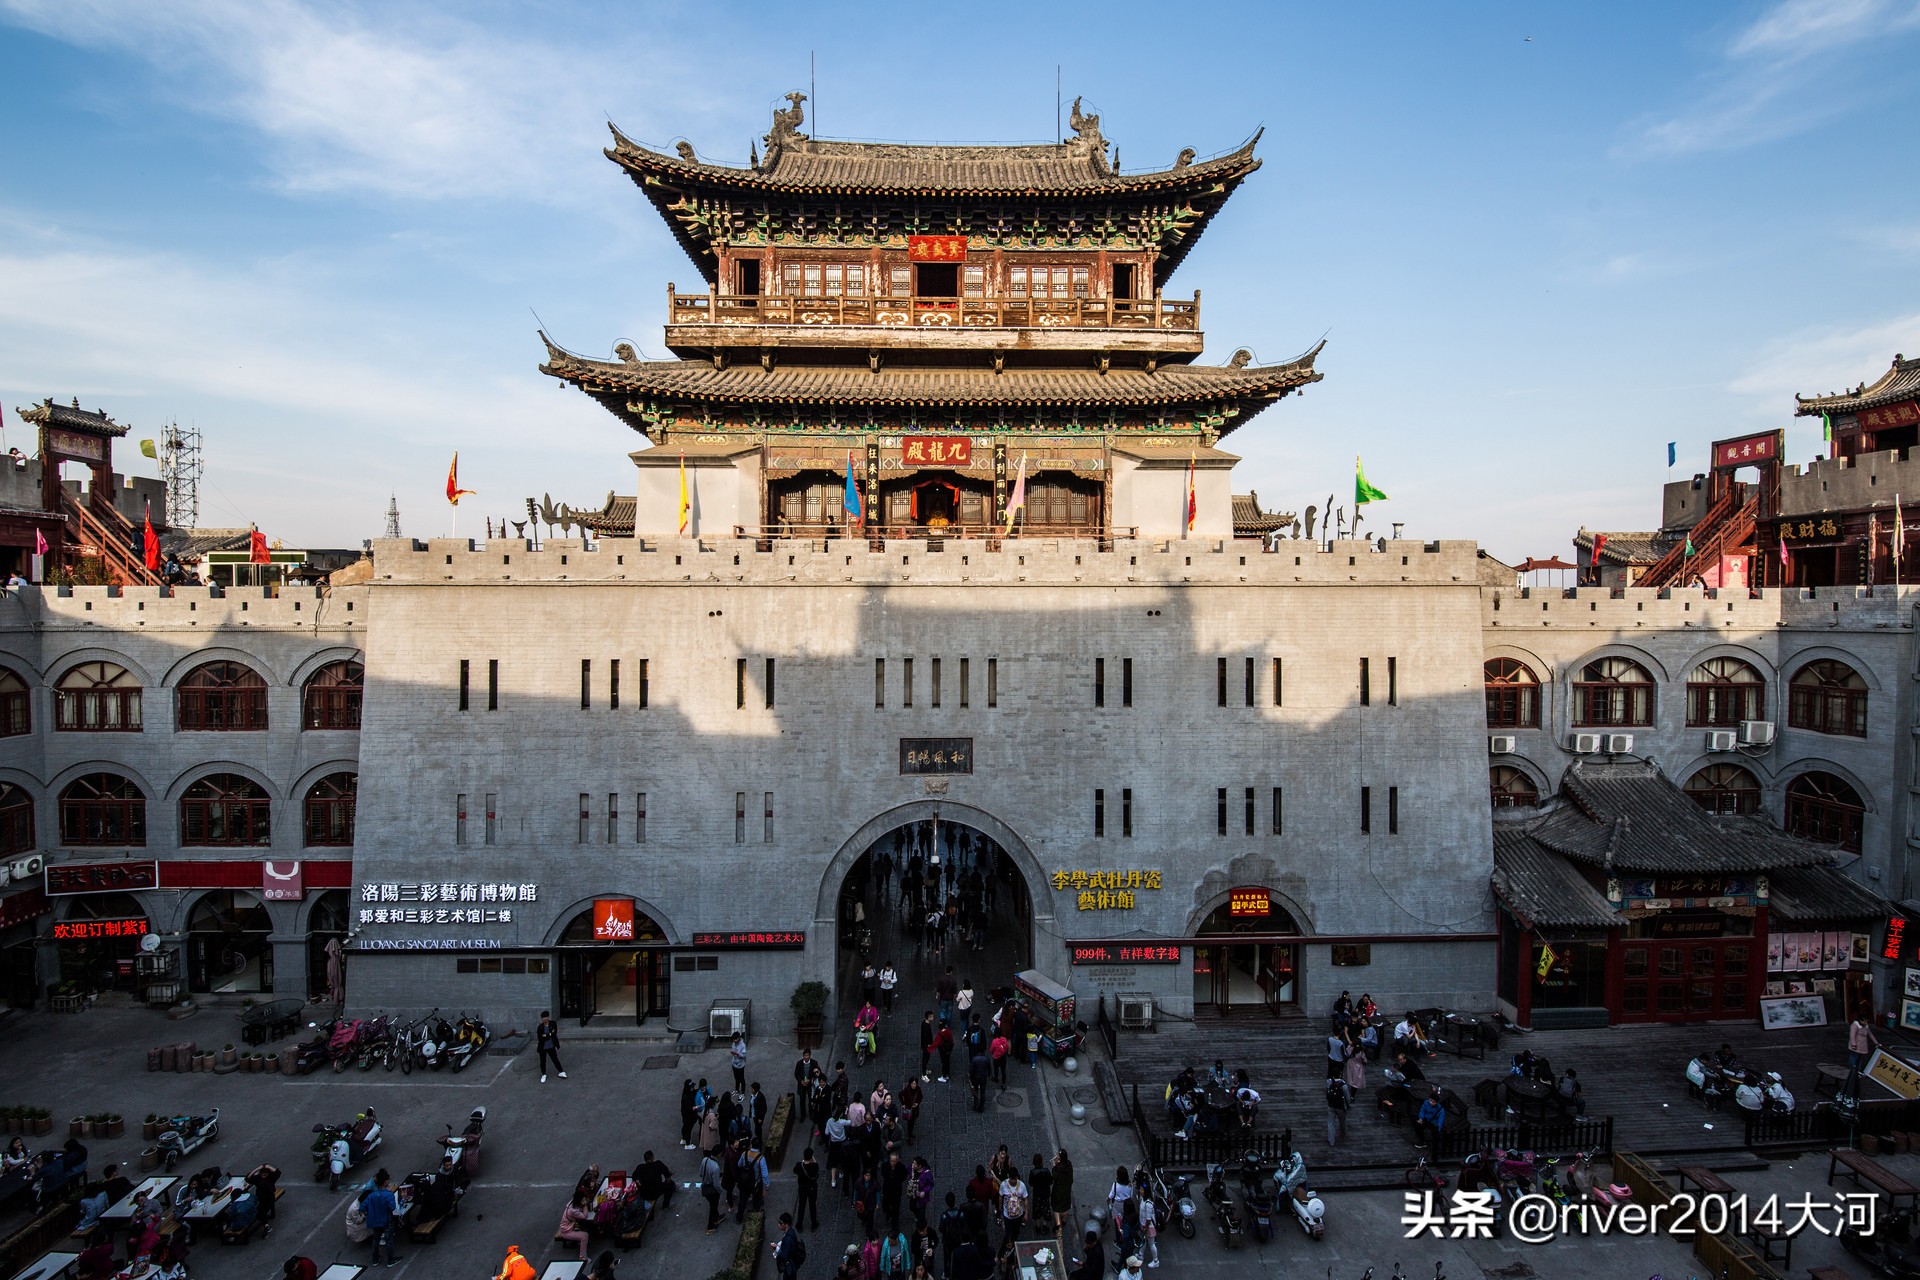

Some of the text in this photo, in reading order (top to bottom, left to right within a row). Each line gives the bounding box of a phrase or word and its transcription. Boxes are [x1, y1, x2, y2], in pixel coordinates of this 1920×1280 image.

[1867, 406, 1918, 426] 觀音殿
[907, 440, 967, 462] 九龍殿
[1051, 869, 1162, 890] 李學武牡丹瓷
[361, 883, 538, 903] 洛陽三彩藝術博物館
[1078, 890, 1135, 910] 藝術館
[360, 939, 405, 950] LUOYANG
[439, 939, 458, 949] ART
[460, 938, 501, 949] MUSEUM
